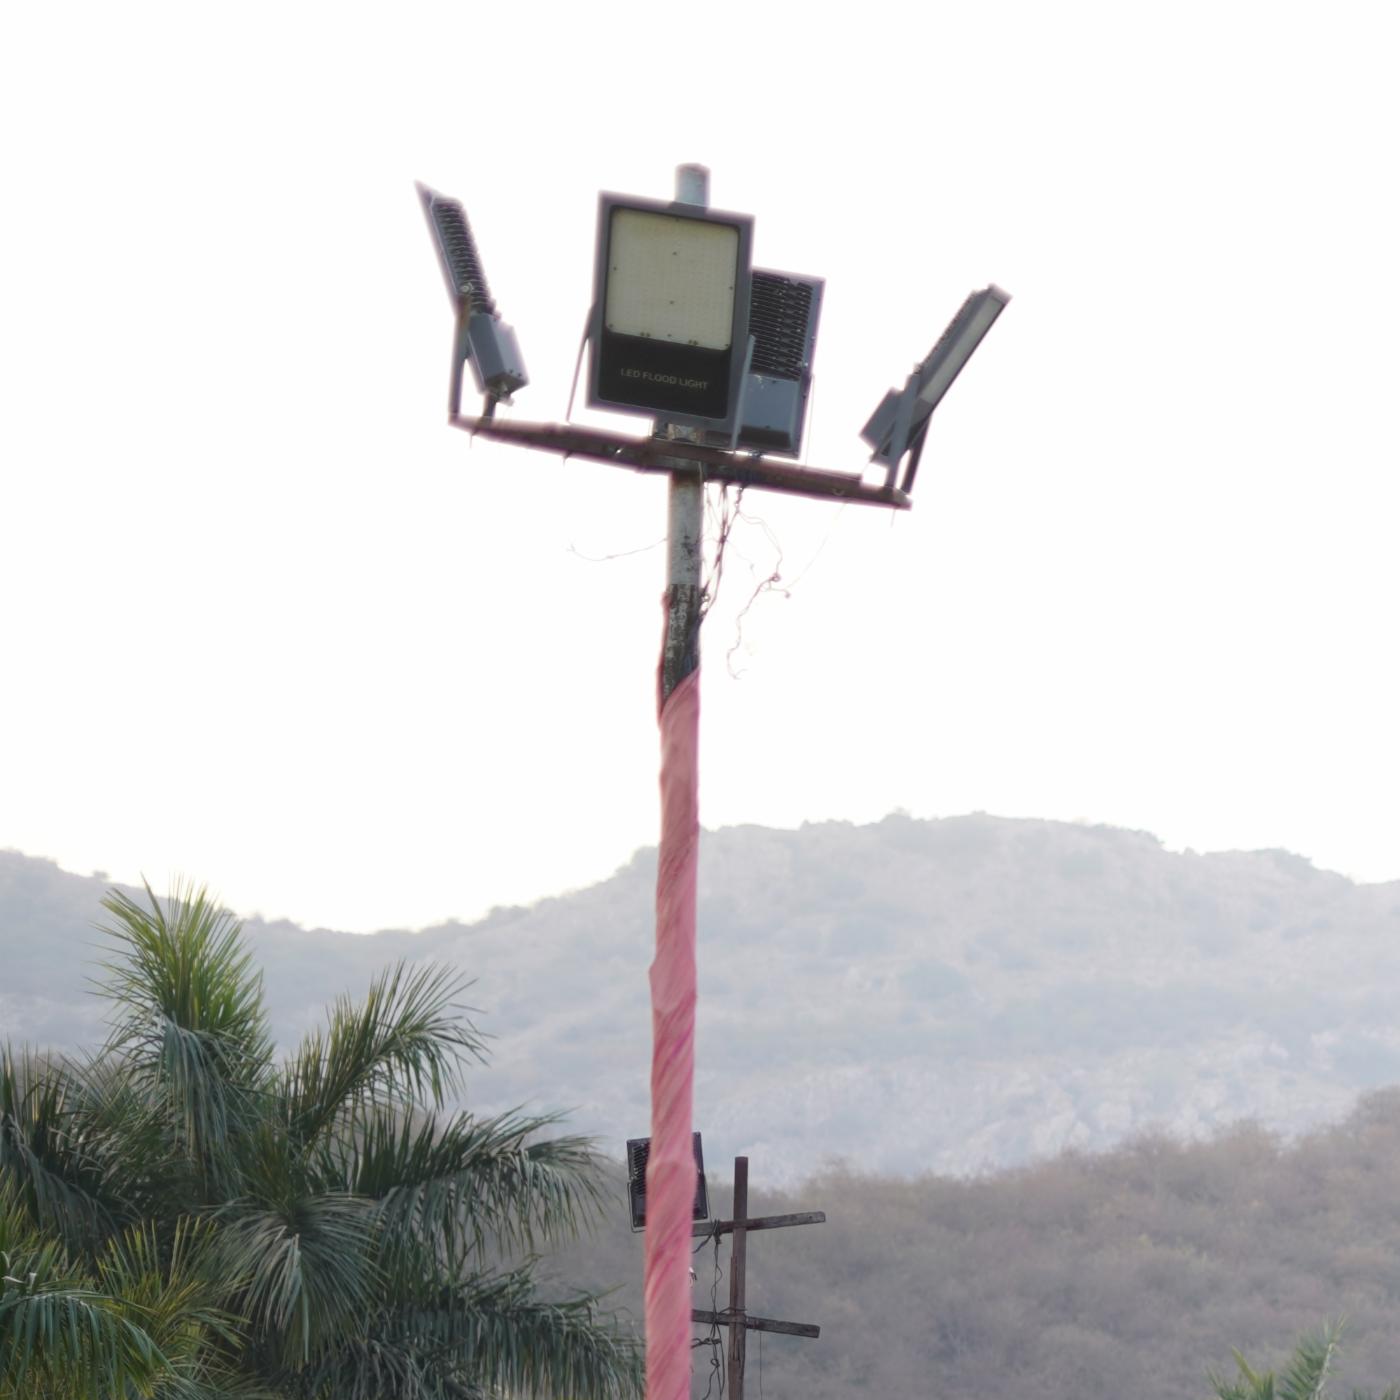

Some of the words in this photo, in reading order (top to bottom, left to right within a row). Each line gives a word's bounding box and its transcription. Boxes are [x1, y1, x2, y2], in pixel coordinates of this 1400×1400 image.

[620, 368, 640, 378] LED
[642, 371, 677, 385] FLOOD
[679, 377, 709, 390] LIGHT
